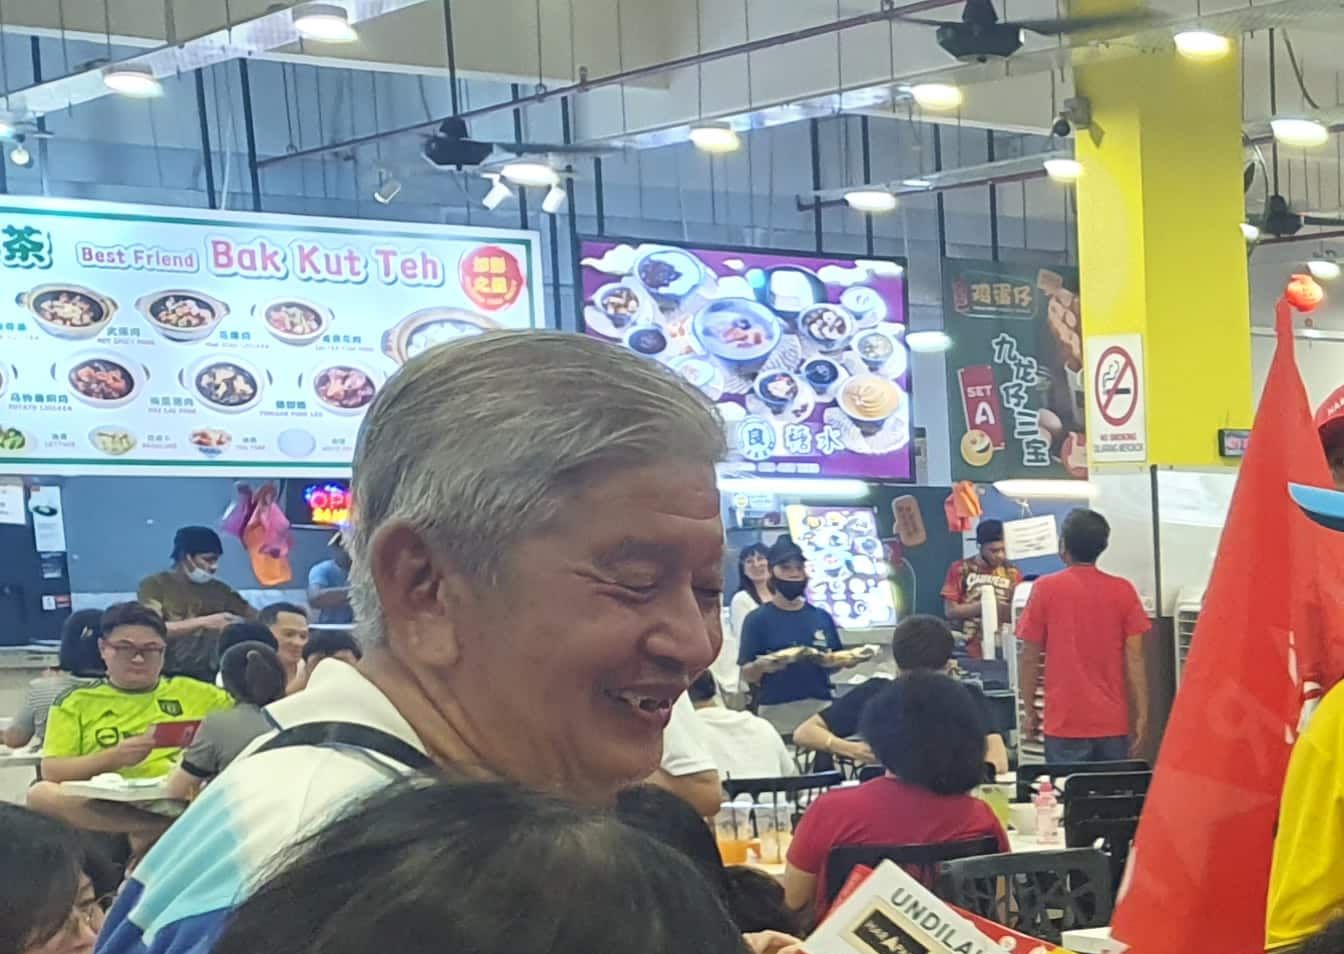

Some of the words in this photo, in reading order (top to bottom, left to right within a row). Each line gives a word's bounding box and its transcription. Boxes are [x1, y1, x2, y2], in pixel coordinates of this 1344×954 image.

[81, 246, 126, 266] Best
[132, 250, 195, 270] Friend
[211, 239, 279, 273] Bak
[297, 245, 362, 277] Kut
[376, 248, 439, 282] Teh
[967, 385, 993, 398] SET
[974, 402, 996, 425] A
